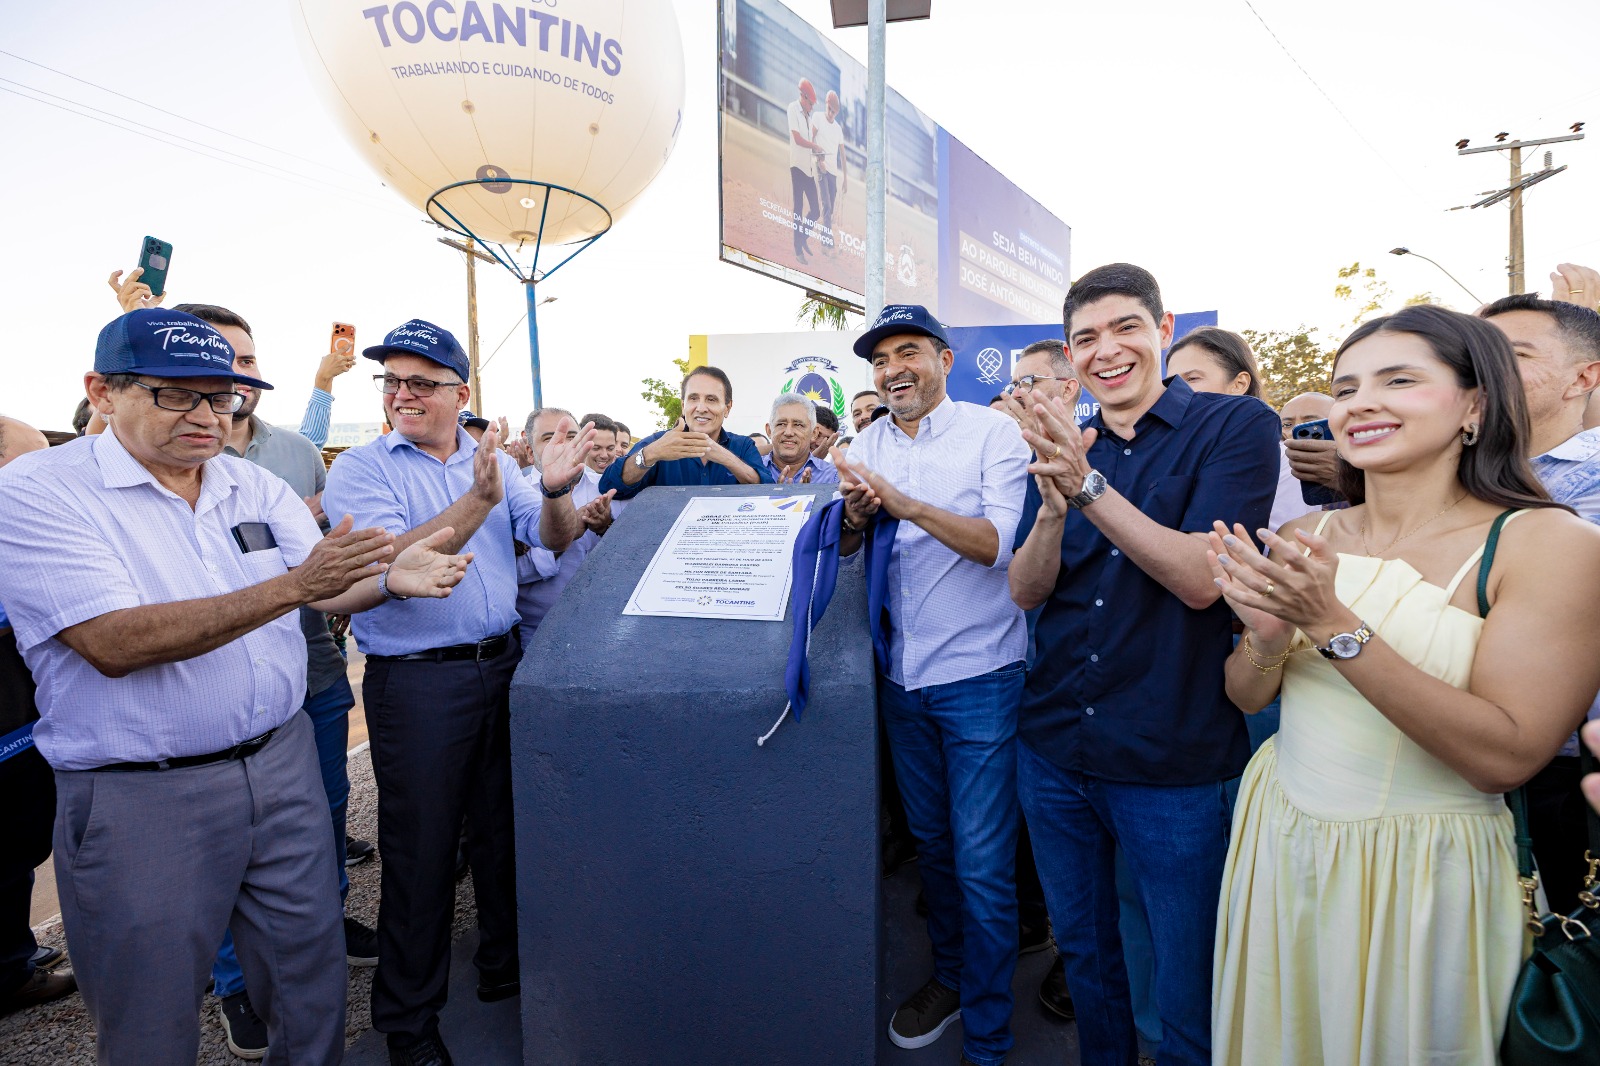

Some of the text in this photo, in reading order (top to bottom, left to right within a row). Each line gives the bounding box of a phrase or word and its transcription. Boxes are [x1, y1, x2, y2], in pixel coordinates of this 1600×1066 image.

[362, 0, 623, 77] TOCANTINS
[391, 61, 614, 105] TRABALHANDO E CUIDANDO DE TODOS
[760, 198, 834, 236] SECRETARIA DA INDÚSTRIA
[762, 210, 834, 246] COMÉRCIO E SERVIÇOS
[962, 240, 977, 258] AO
[980, 248, 1018, 281] PARQUE
[992, 231, 1064, 284] SEJA BEM VINDO
[962, 266, 988, 292] JOSÉ
[990, 282, 1030, 312] ANTÔNIO
[1032, 302, 1043, 318] DE
[154, 326, 230, 354] Tocantins
